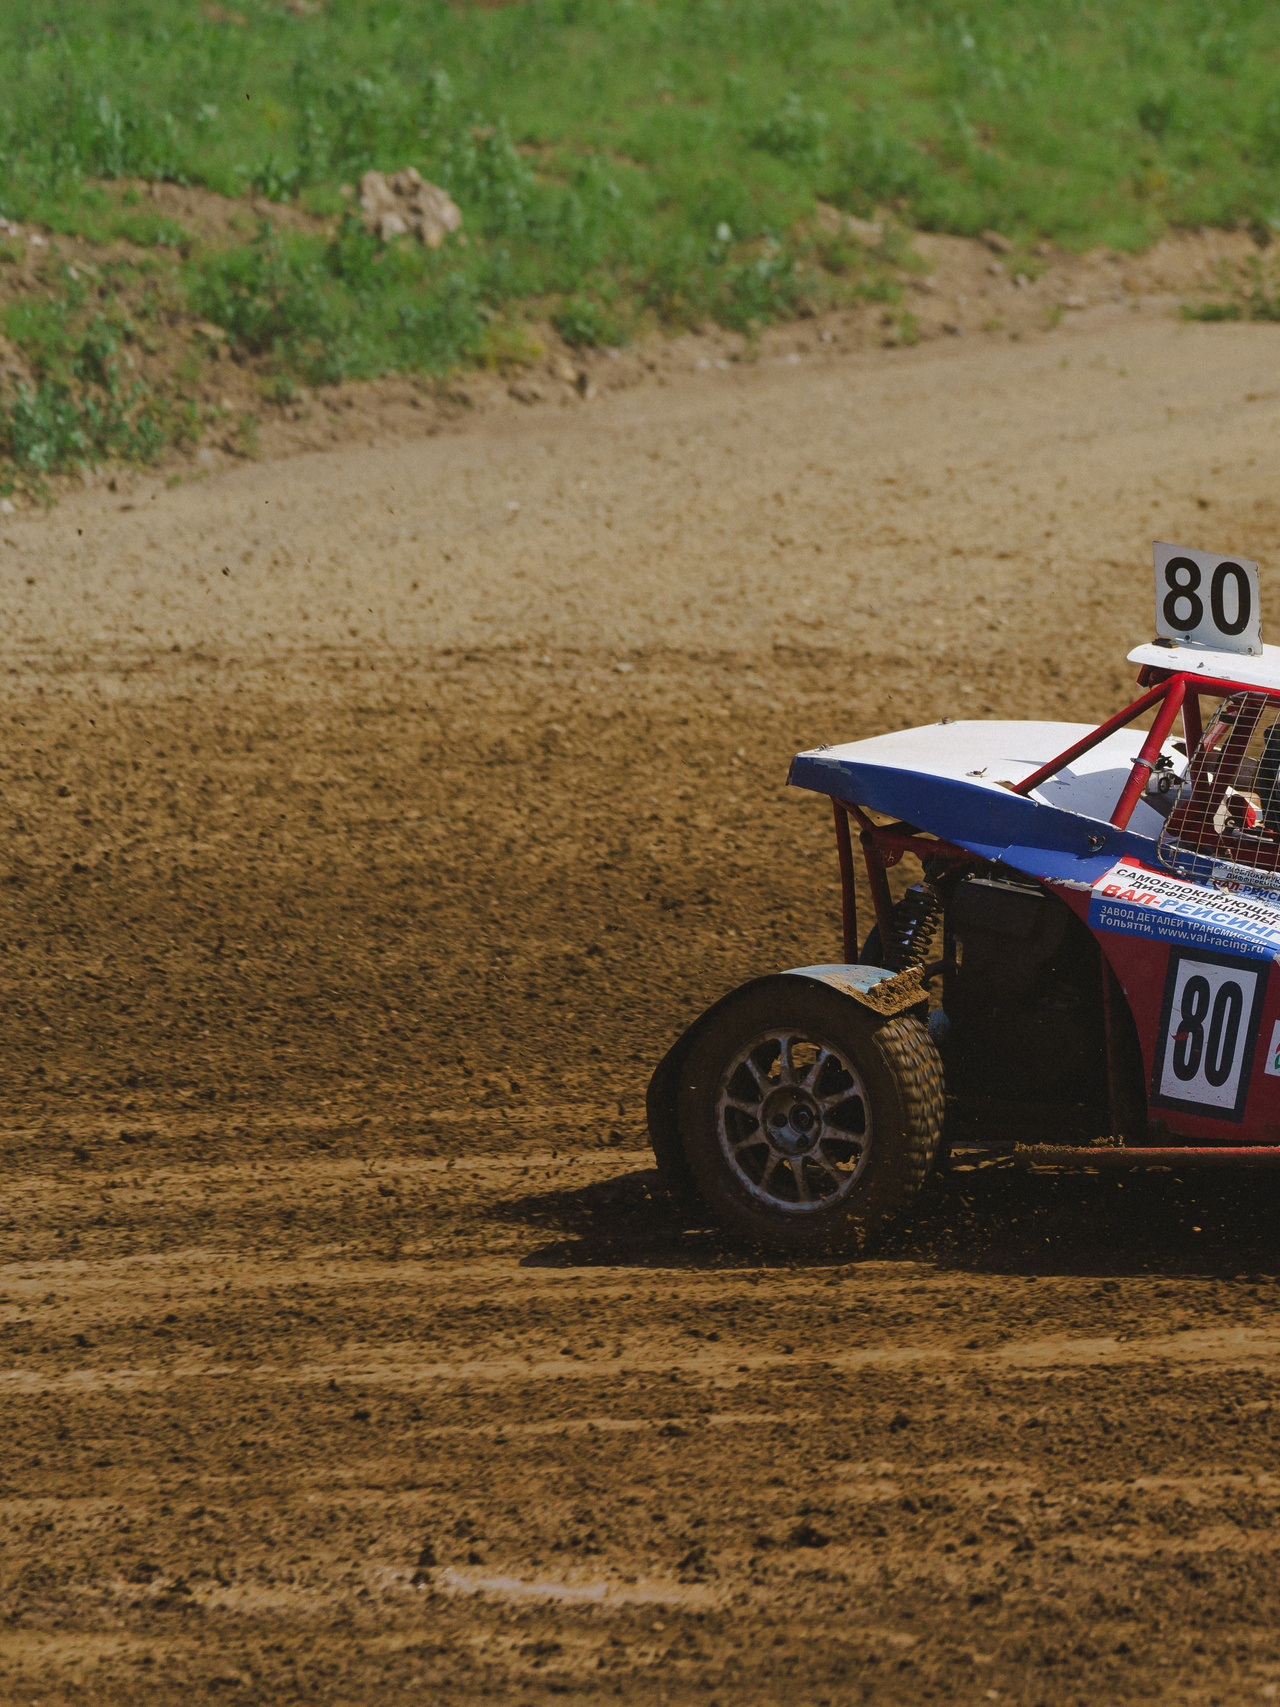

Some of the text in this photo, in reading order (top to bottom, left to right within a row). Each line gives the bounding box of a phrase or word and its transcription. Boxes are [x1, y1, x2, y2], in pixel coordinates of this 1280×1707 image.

[1163, 556, 1251, 636] 80
[1100, 905, 1268, 946] ЗАВОД ДЕТАЛЕЙ ТРАНСМИССИИ
[1128, 880, 1276, 926] ДИФФЕРЕНЦИАЛЫ
[1099, 913, 1265, 954] Тольятти, www.val-racing.ru
[1172, 975, 1244, 1088] 80
